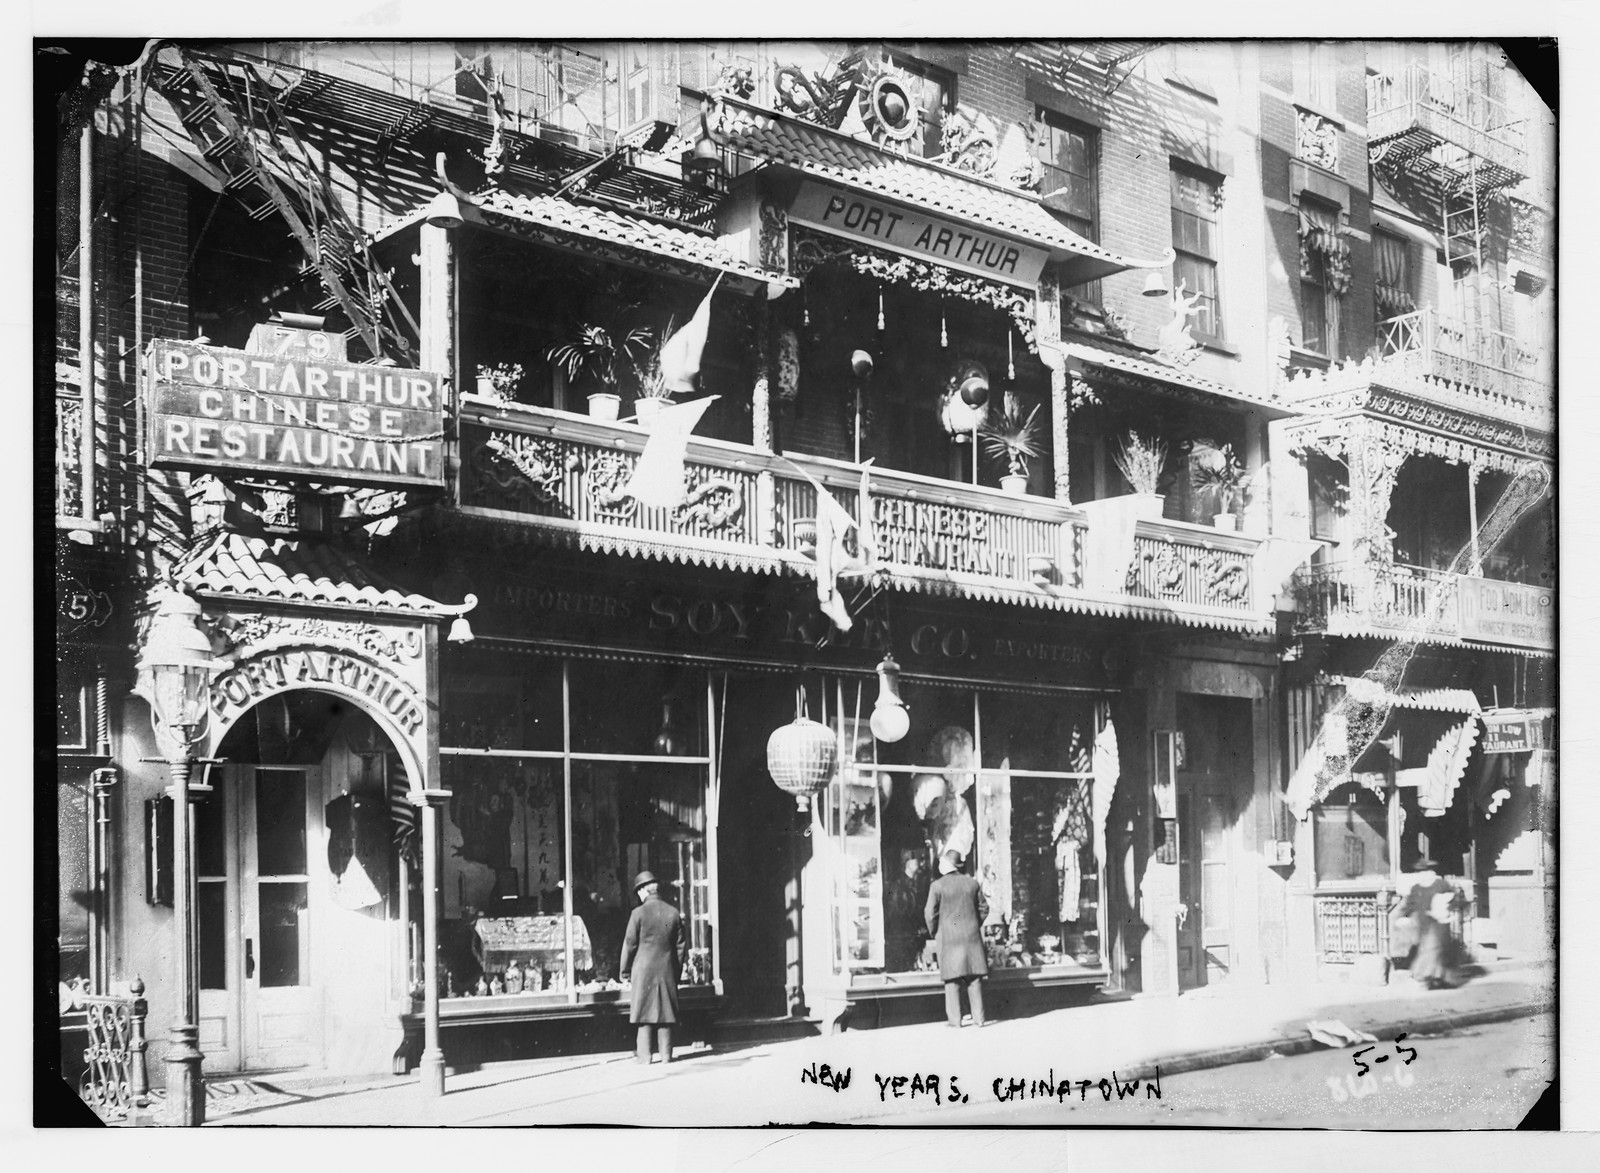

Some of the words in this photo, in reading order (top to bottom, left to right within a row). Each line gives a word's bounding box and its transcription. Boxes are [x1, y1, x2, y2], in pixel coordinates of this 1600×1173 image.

[823, 195, 903, 239] PORT
[914, 223, 1020, 274] ARTHUR
[276, 329, 330, 359] 7-9
[200, 390, 403, 436] CHINESE
[165, 419, 434, 475] RESTAURANT
[870, 497, 986, 541] CHINESE
[876, 531, 1014, 578] STAURANT
[495, 584, 632, 618] IMPORTERS
[649, 595, 761, 639] SOY
[910, 624, 977, 660] CO.
[994, 638, 1092, 664] EXPORTERS
[209, 654, 289, 725] PORT
[296, 651, 424, 738] ARTHUR
